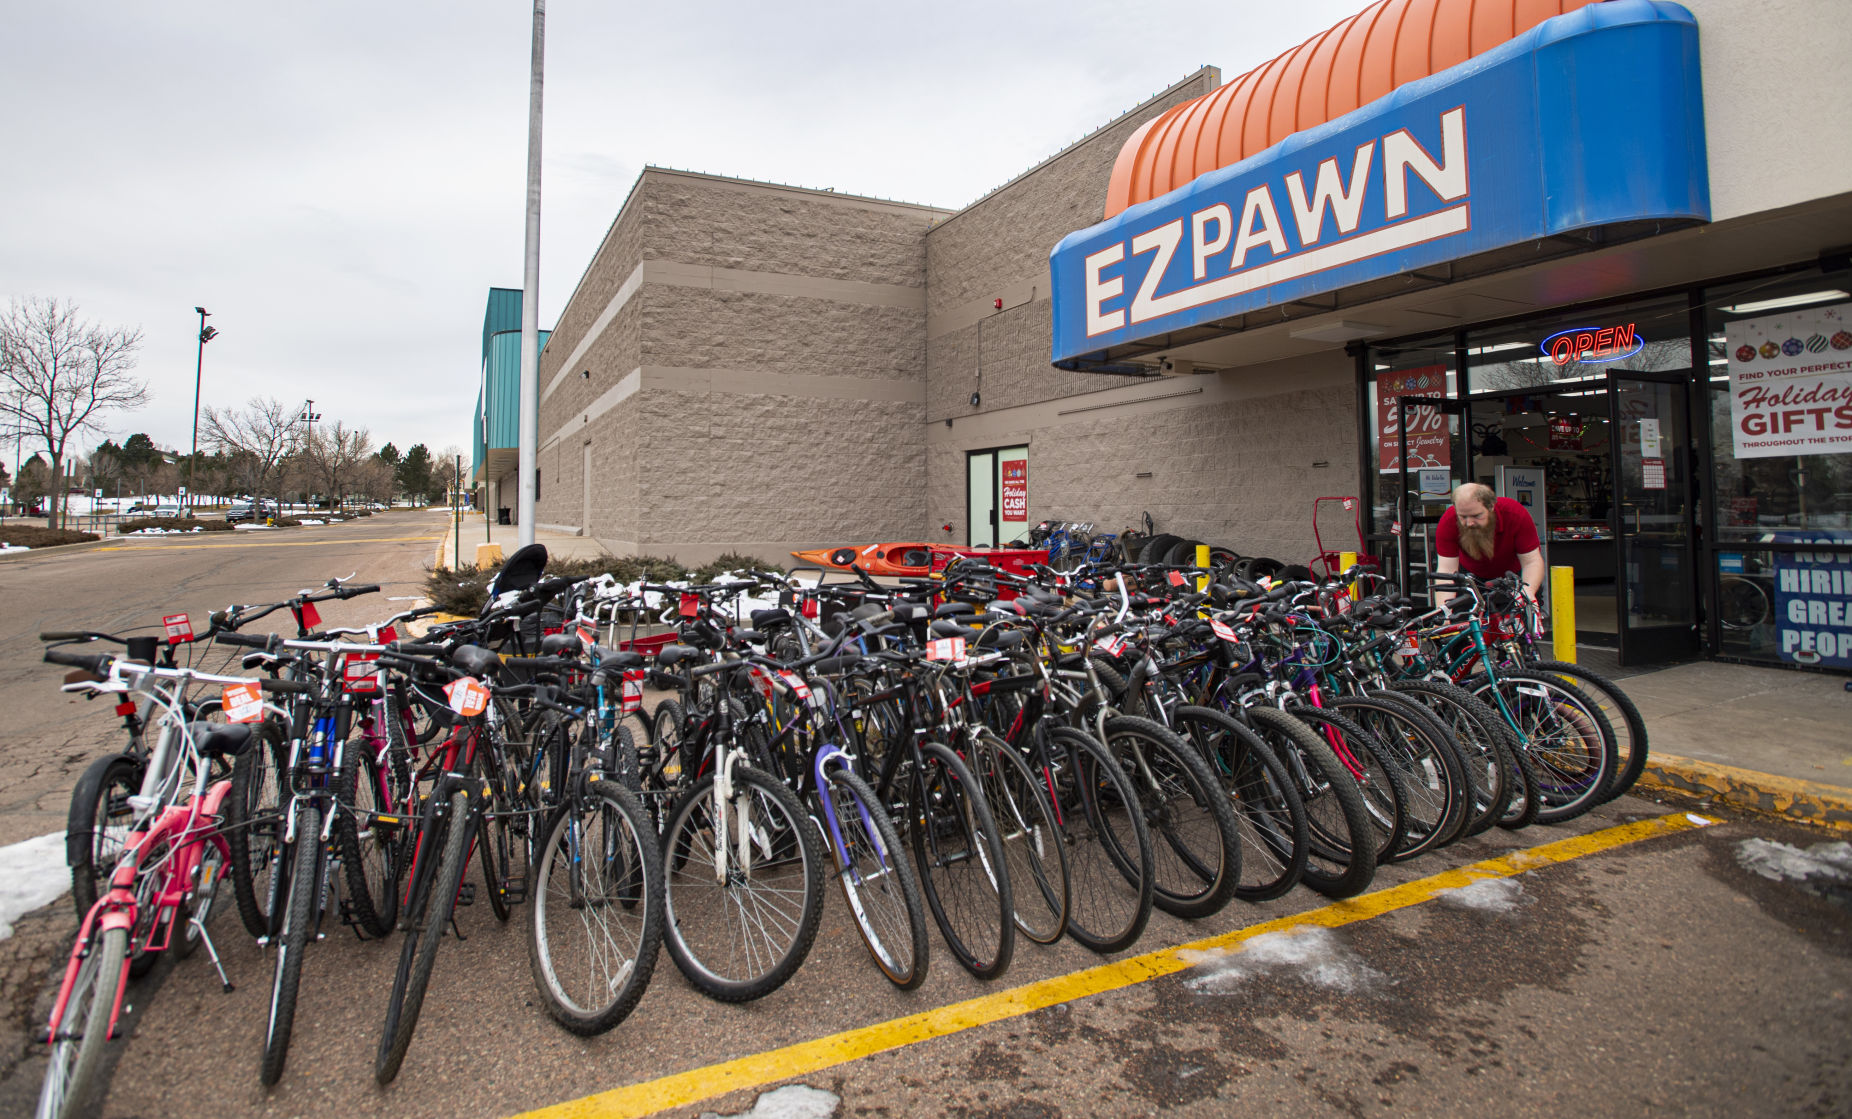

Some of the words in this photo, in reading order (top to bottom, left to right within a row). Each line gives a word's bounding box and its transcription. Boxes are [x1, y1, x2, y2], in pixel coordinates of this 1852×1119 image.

[1085, 104, 1471, 338] EZPAWN
[1552, 323, 1635, 366] OPEN
[1738, 371, 1764, 381] FIND
[1767, 367, 1798, 378] YOUR
[1801, 360, 1852, 373] PERFECT
[1738, 382, 1852, 411] Holiday
[1741, 405, 1852, 436] GIFTS
[1416, 435, 1444, 449] Jewelry
[1742, 438, 1805, 449] THROUGHOUT
[1808, 436, 1827, 444] THE
[1003, 486, 1026, 498] Holiday
[1003, 498, 1026, 509] CASH
